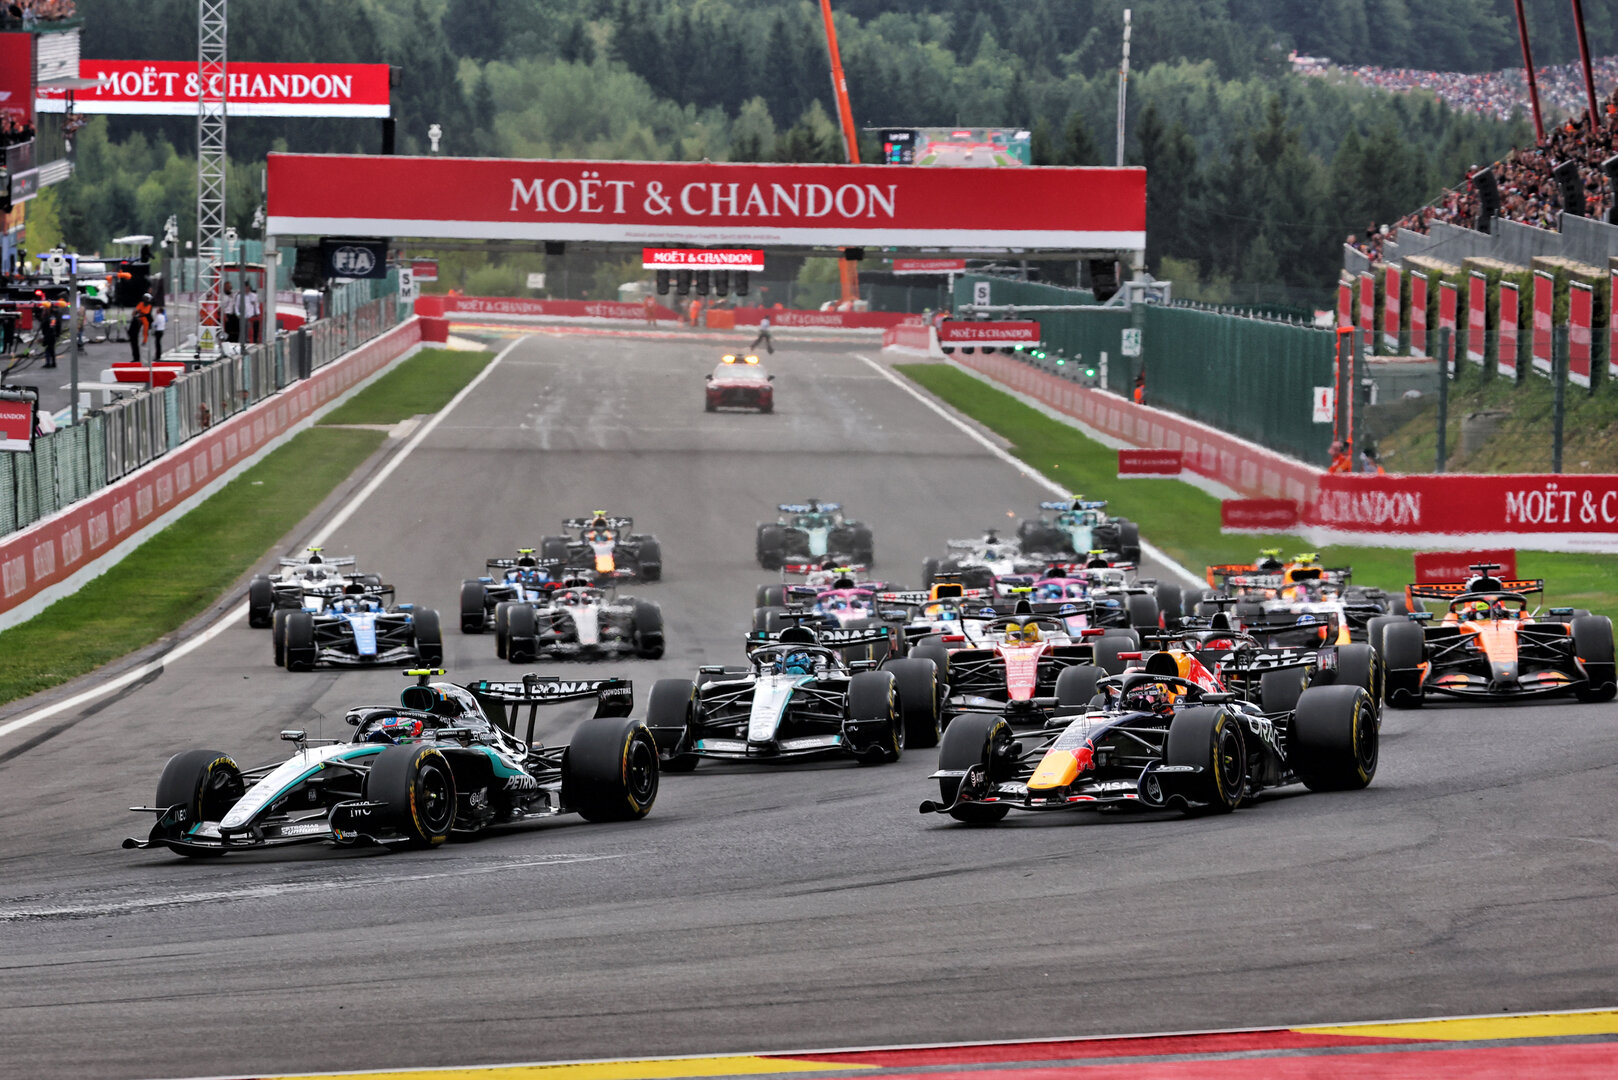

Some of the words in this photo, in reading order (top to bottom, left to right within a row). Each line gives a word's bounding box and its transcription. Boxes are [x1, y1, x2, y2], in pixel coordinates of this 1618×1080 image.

[95, 66, 179, 96] MOËT
[184, 72, 205, 97] &
[208, 73, 352, 98] CHANDON
[509, 170, 634, 214] MOËT
[643, 181, 673, 215] &
[680, 182, 898, 218] CHANDON
[653, 251, 685, 262] MOËT
[688, 253, 697, 262] &
[697, 253, 753, 263] CHANDON
[402, 273, 410, 285] S
[402, 288, 411, 297] M
[977, 287, 987, 299] S
[949, 328, 976, 337] MOËT
[1505, 482, 1577, 524] MOËT
[1580, 489, 1598, 524] &
[1601, 490, 1618, 524] C
[1093, 781, 1134, 791] VISA
